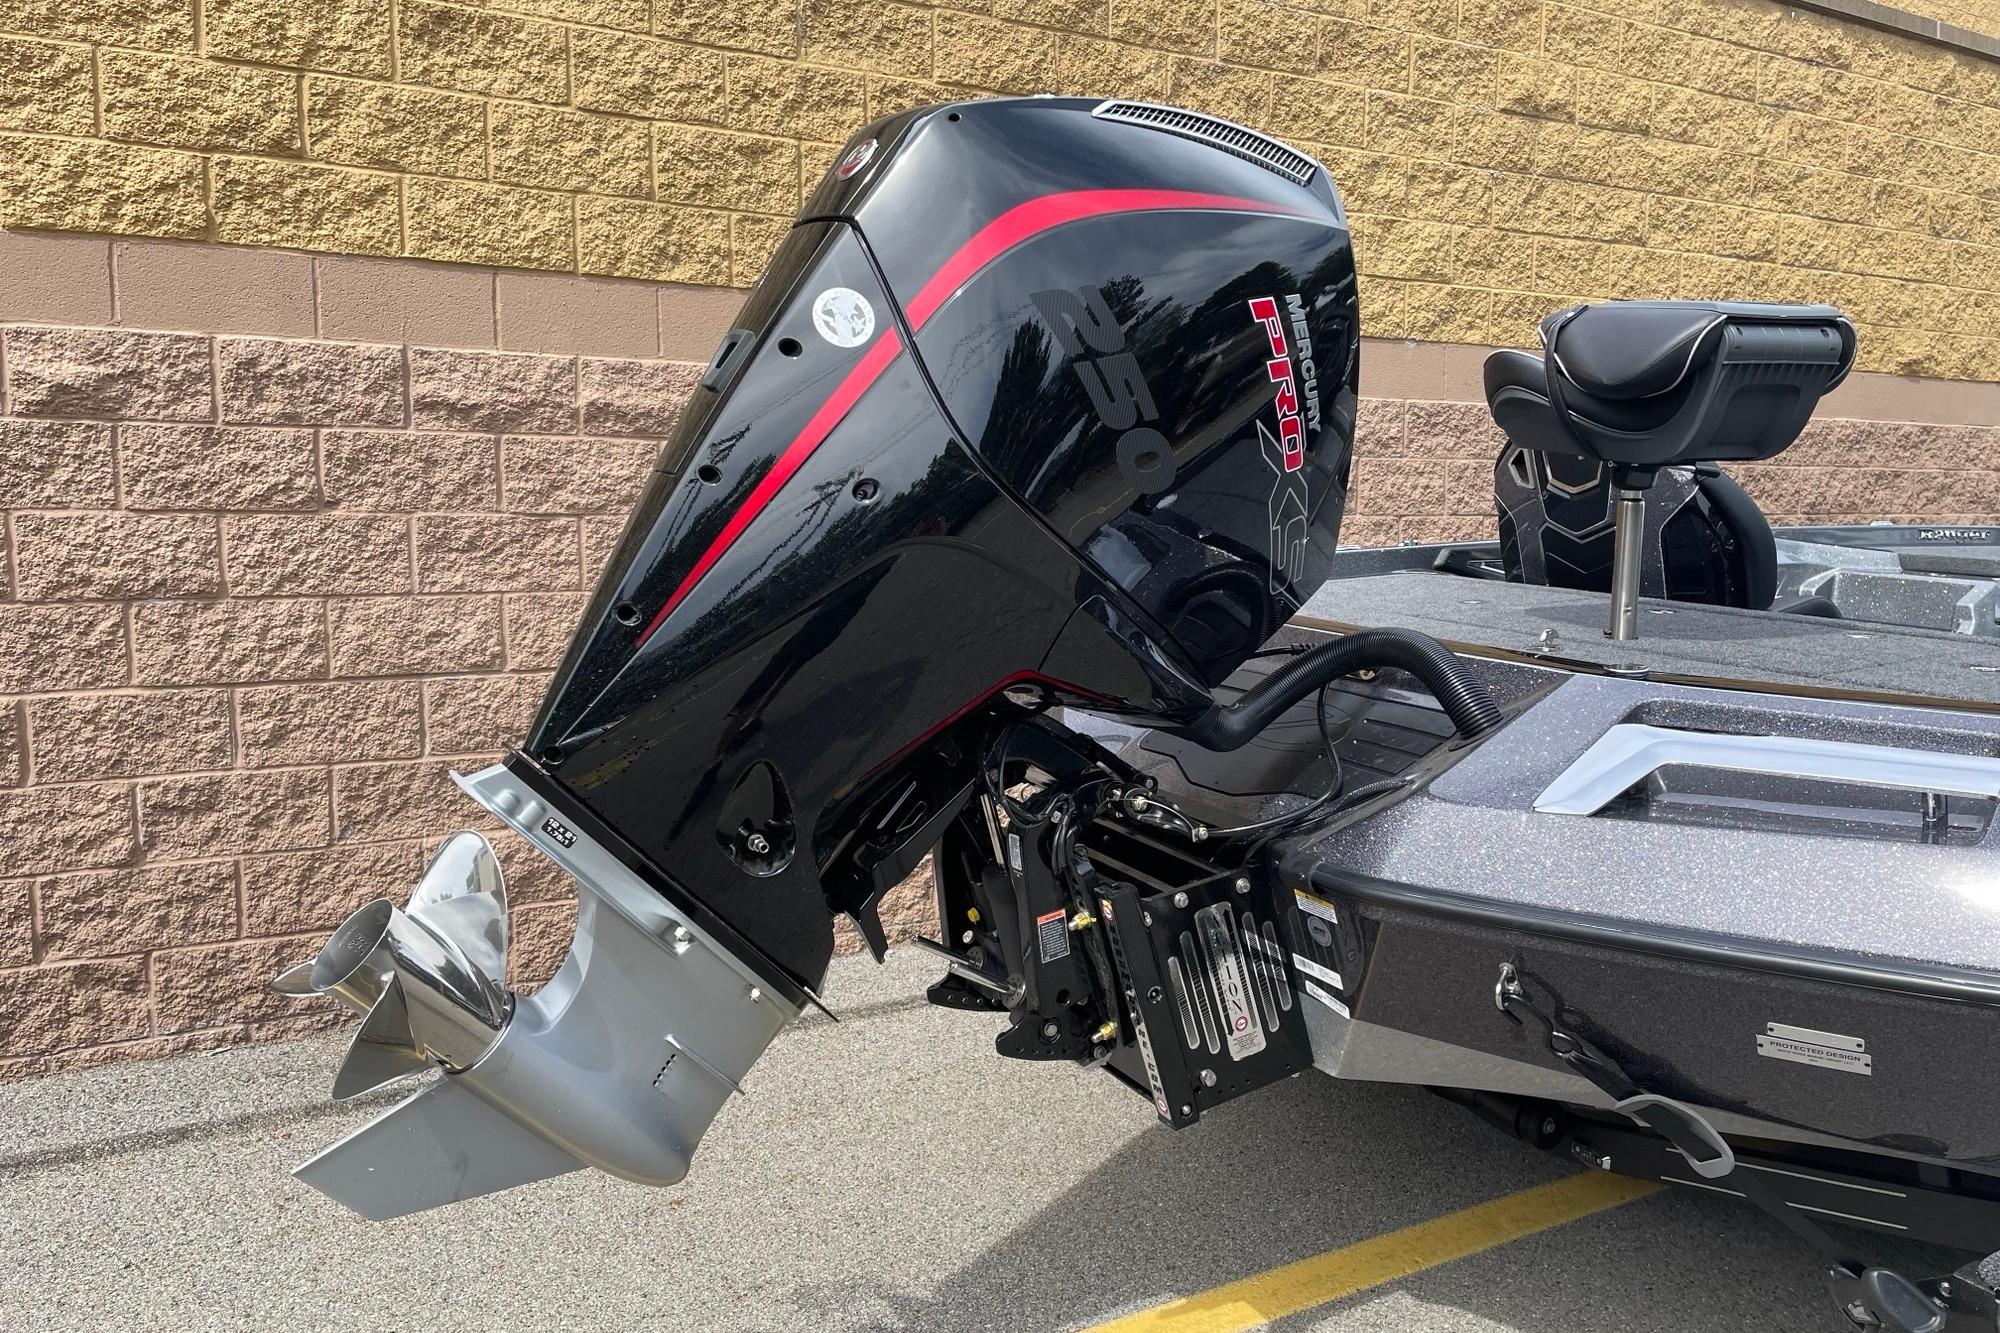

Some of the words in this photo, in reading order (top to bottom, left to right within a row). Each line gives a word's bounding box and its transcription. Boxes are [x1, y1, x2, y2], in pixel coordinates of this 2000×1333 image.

[1028, 285, 1178, 494] 250
[1248, 296, 1304, 473] PRO
[1285, 294, 1321, 432] MERCURY
[1256, 411, 1308, 596] XS
[548, 818, 560, 829] 12
[564, 831, 577, 842] 21
[1770, 1041, 1824, 1056] PROTECTED
[1826, 1051, 1861, 1062] DESIGN
